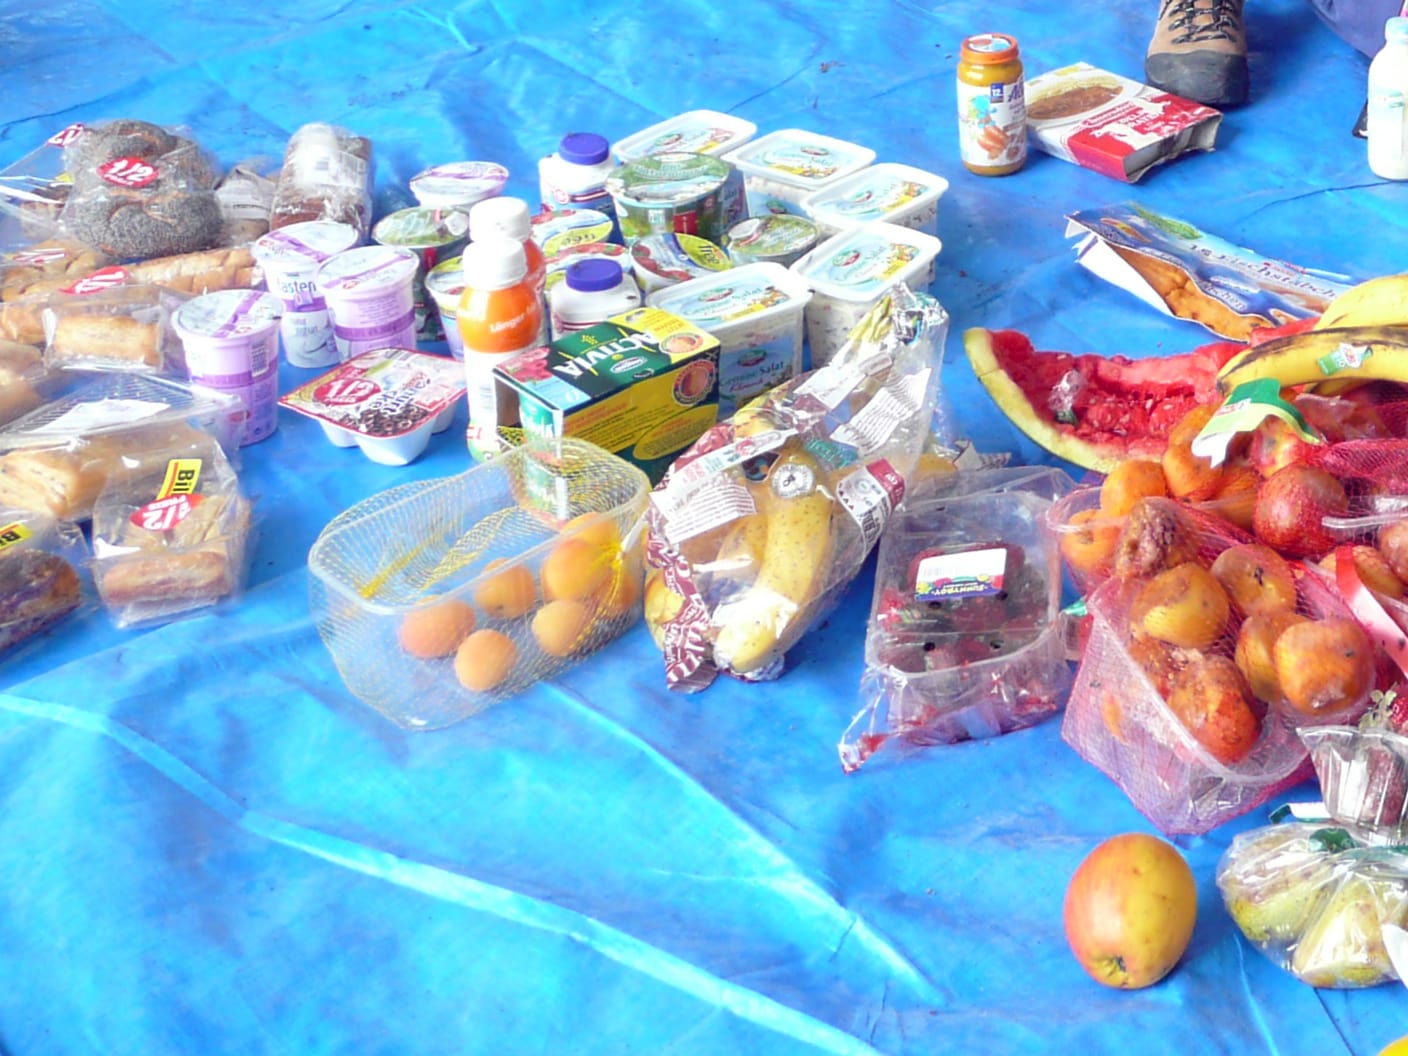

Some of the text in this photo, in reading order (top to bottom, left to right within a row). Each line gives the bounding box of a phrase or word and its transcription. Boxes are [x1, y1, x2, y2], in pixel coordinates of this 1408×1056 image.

[107, 159, 148, 183] 1/2
[552, 330, 661, 378] ACTIVIA
[319, 379, 372, 401] 1/2
[172, 469, 196, 495] Bil
